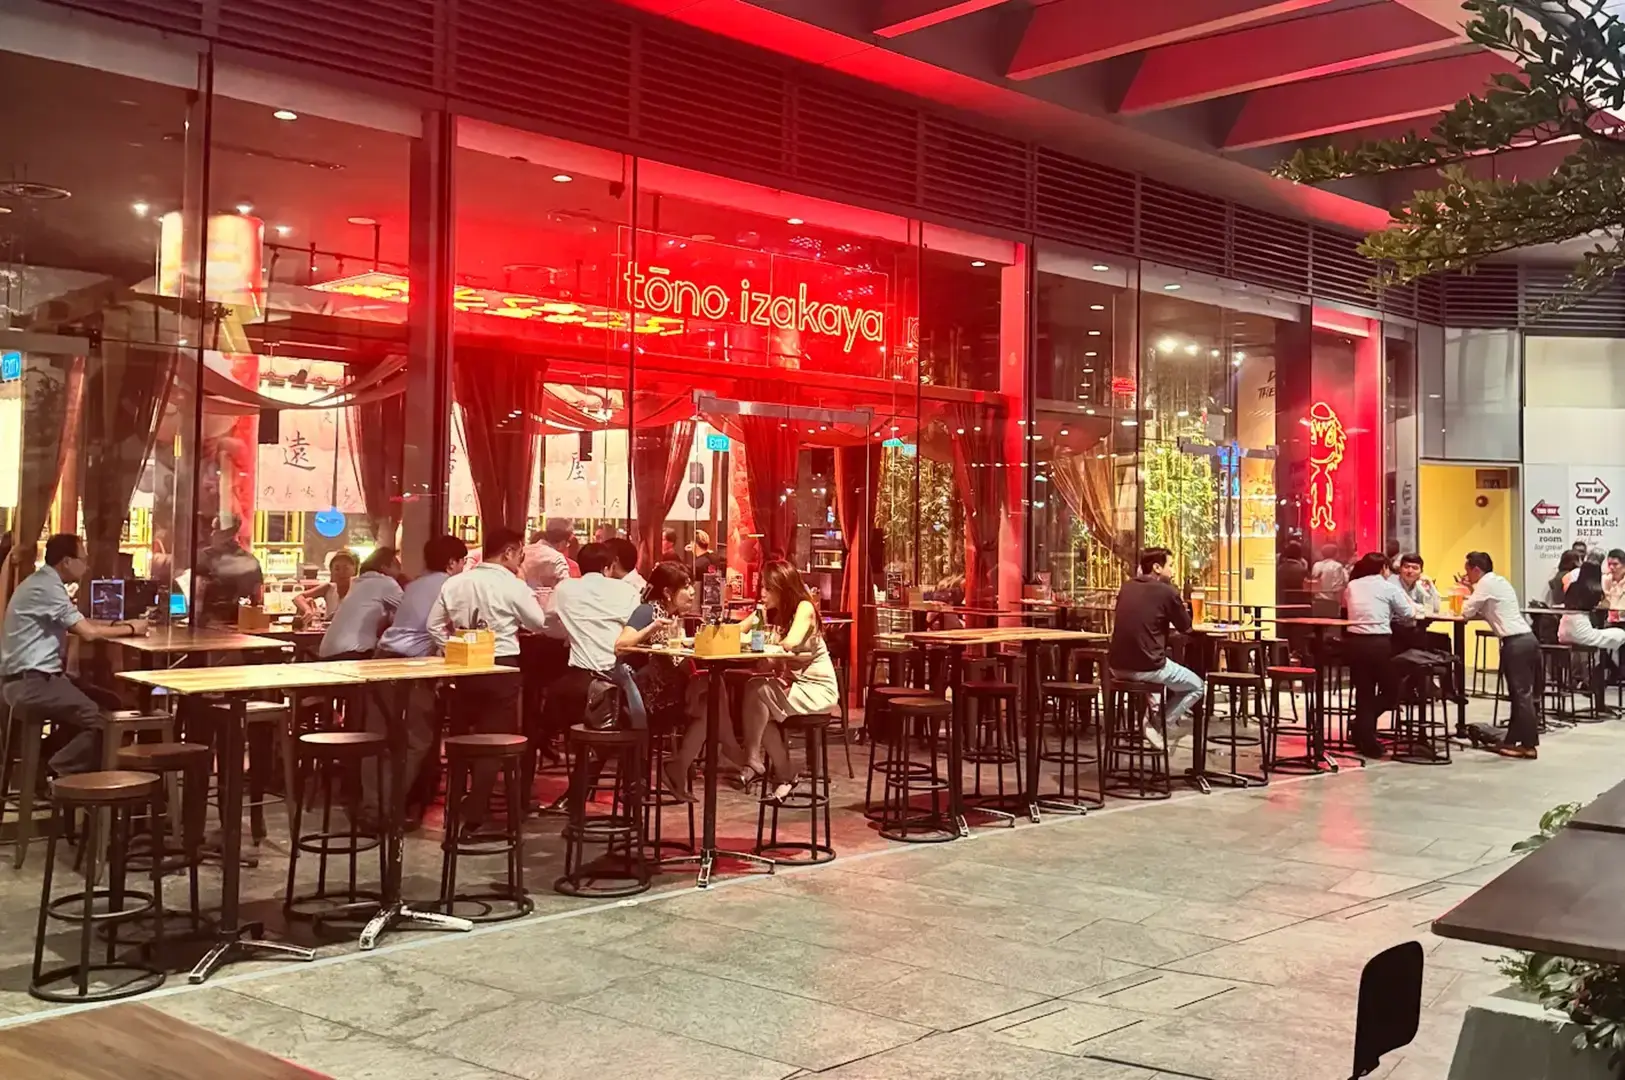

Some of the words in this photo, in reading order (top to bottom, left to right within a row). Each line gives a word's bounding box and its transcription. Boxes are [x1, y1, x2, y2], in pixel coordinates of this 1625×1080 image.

[623, 260, 729, 320] tōno
[740, 278, 884, 353] izakaya
[283, 430, 316, 471] 遠
[1576, 505, 1609, 516] Great
[1576, 516, 1619, 527] drinks!
[1537, 526, 1562, 534] make
[1577, 528, 1603, 536] BEER
